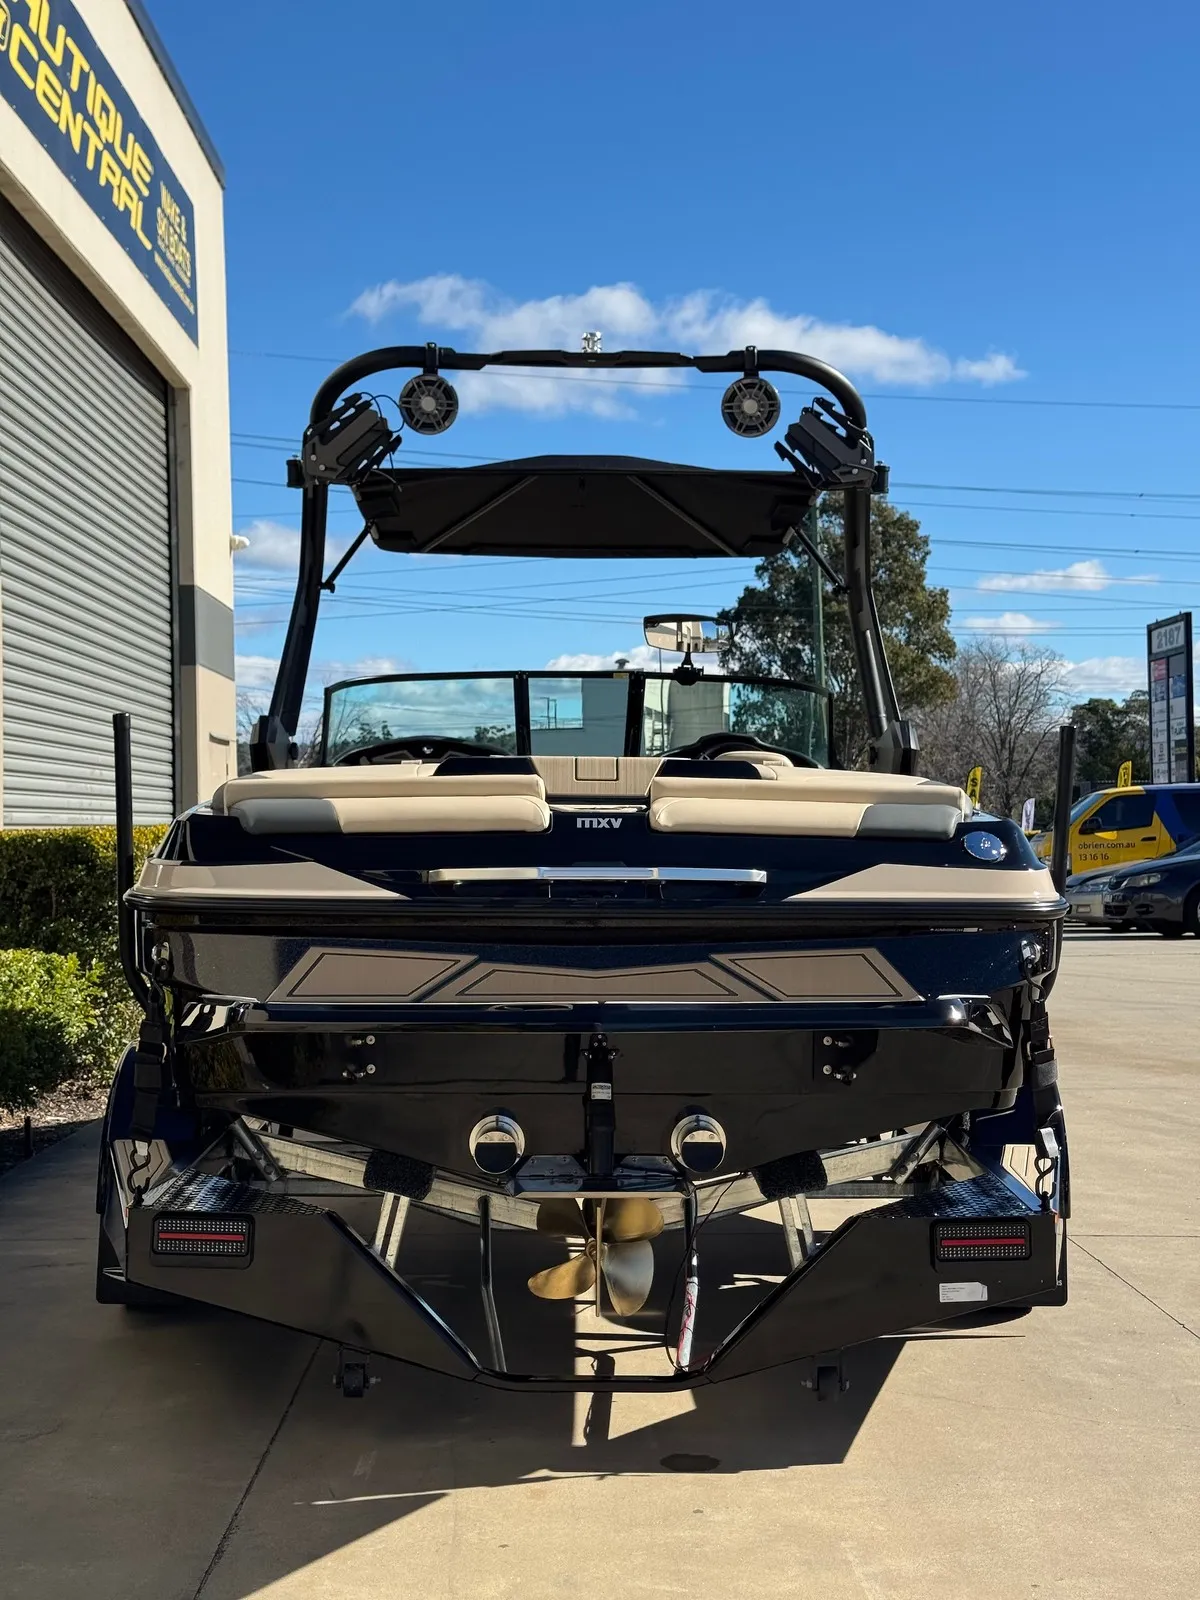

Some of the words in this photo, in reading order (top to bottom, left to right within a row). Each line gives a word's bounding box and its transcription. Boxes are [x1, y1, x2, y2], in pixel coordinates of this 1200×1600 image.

[9, 23, 153, 250] CENTRAL
[1156, 625, 1182, 649] 2187
[1078, 841, 1136, 850] obrien.com.au
[1079, 853, 1087, 861] 13
[1090, 853, 1098, 861] 16
[1101, 853, 1109, 861] 16
